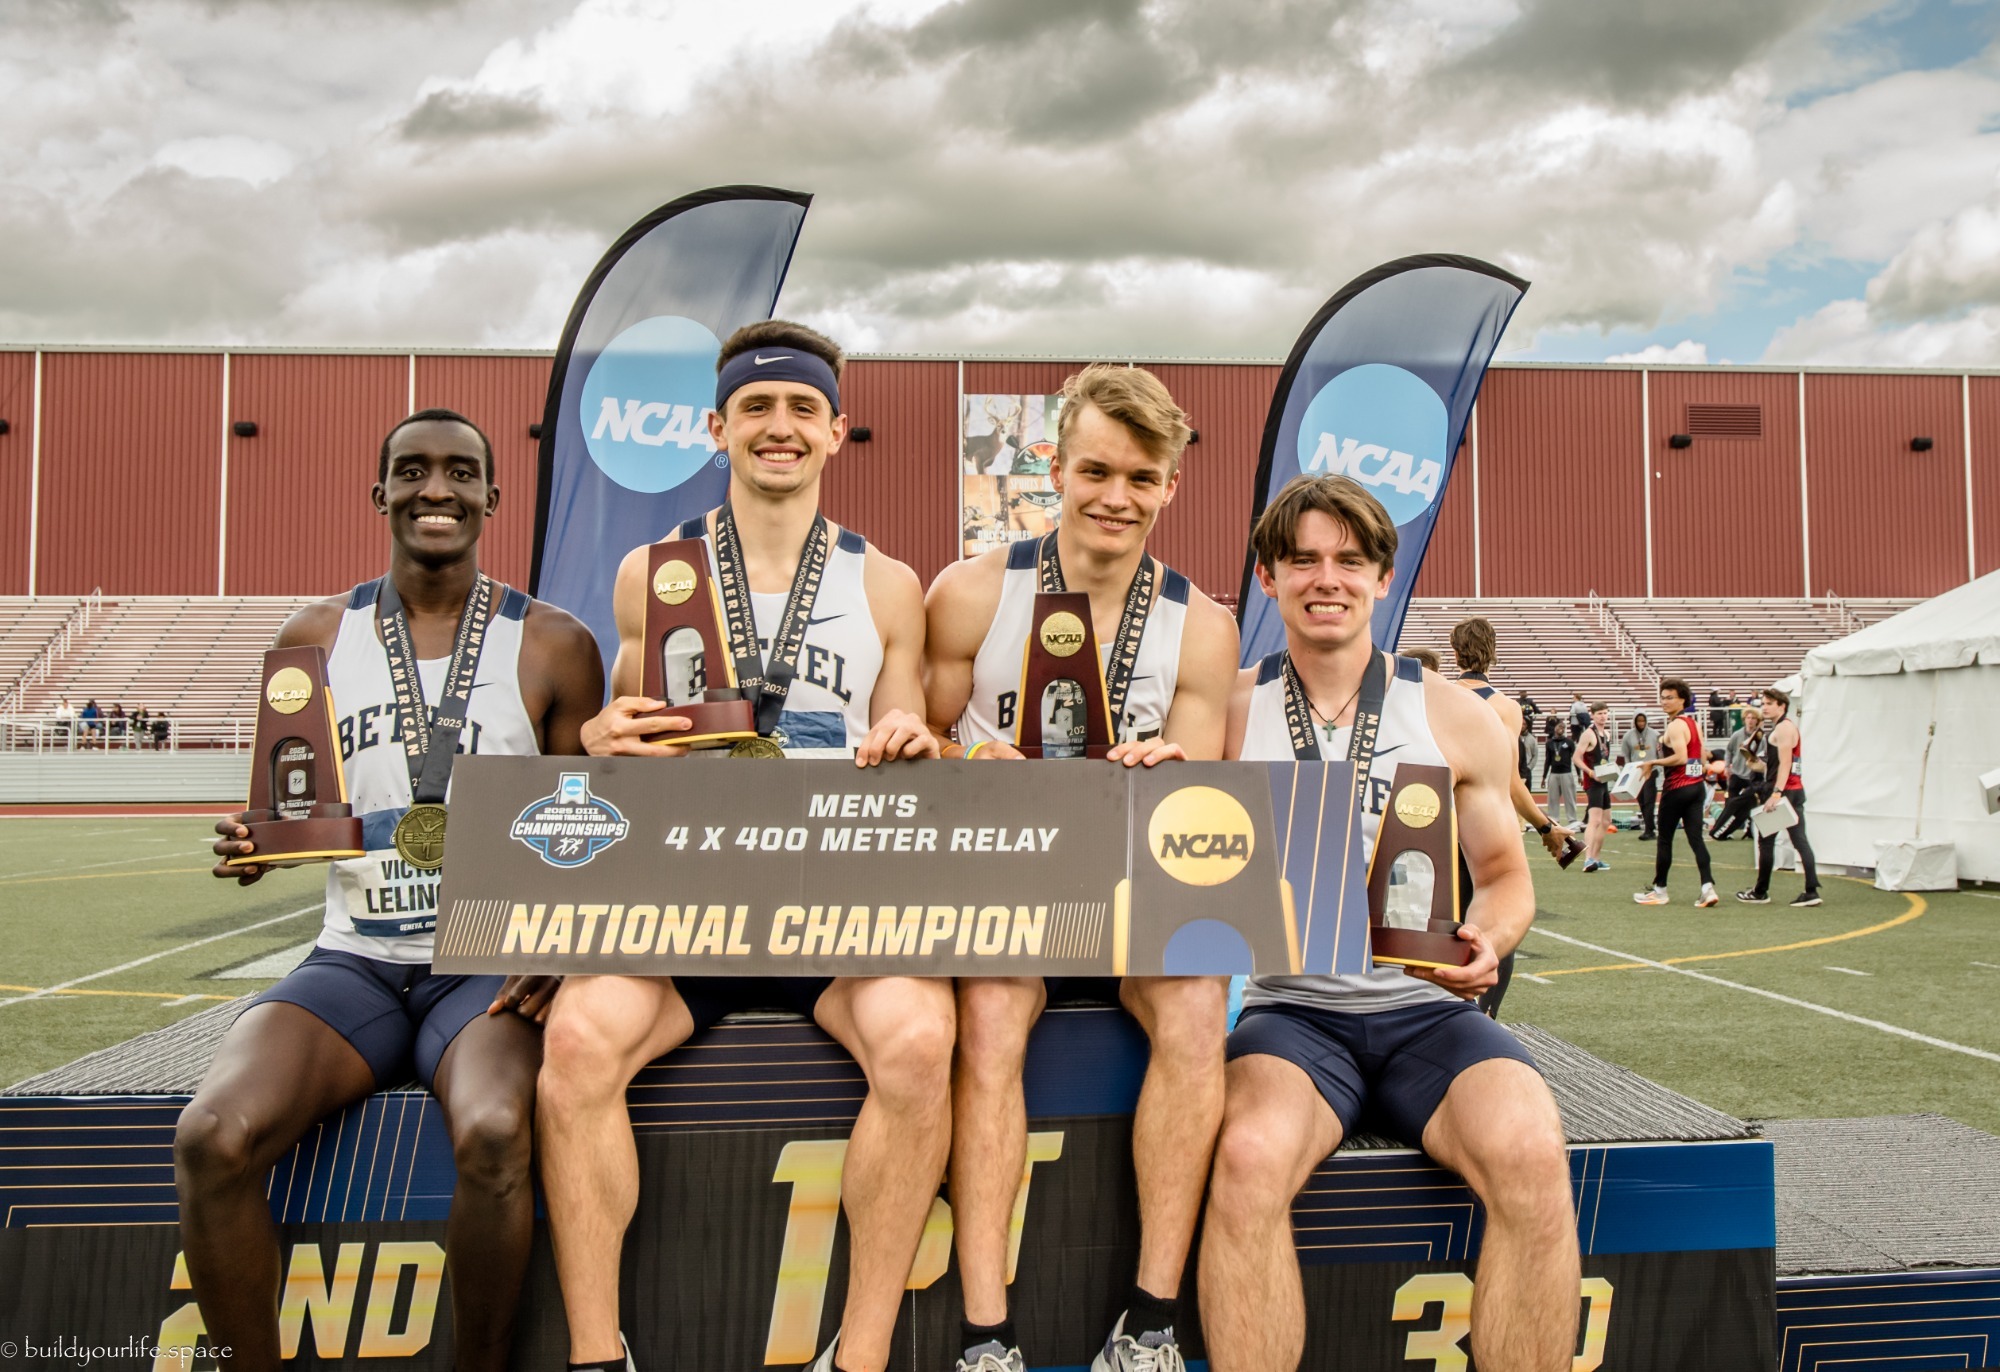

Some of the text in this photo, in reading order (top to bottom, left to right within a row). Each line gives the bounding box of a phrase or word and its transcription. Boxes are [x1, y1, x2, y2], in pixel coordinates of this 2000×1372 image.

[591, 397, 718, 453] NCAA
[1308, 432, 1441, 502] NCAA
[657, 580, 694, 595] NCAA
[717, 522, 748, 659] ALL-AMERICAN
[784, 530, 828, 667] ALL-AMERICAN
[774, 641, 785, 662] NCAA
[780, 608, 795, 641] DIVISION
[792, 568, 807, 602] OUTDOOR
[1117, 614, 1131, 649] OUTDOOR
[1127, 591, 1137, 613] TRACK
[456, 573, 489, 700] ALL-AMERICAN
[1046, 634, 1082, 645] NCAA
[1110, 571, 1153, 714] ALL-AMERICAN
[446, 676, 457, 697] NCAA
[461, 605, 474, 639] OUTDOOR
[269, 690, 310, 702] NCAA
[383, 617, 420, 757] ALL-AMERICAN
[407, 667, 420, 704] OUTDOOR
[740, 677, 764, 689] 2025
[764, 682, 788, 696] 2025
[437, 717, 463, 728] 2025
[1068, 725, 1086, 736] 202
[280, 753, 307, 762] DIVISION
[289, 746, 306, 754] 2025
[808, 794, 918, 818] MEN'S
[1398, 803, 1437, 819] NCAA
[514, 822, 625, 836] CHAMPIONSHIPS
[665, 827, 1059, 852] 4 X 400 METER RELAY
[1160, 833, 1249, 860] NCAA
[365, 882, 440, 914] LELIN
[400, 921, 424, 931] GENEVA,
[501, 904, 1048, 956] NATIONAL CHAMPION
[1391, 1272, 1614, 1372] 3D
